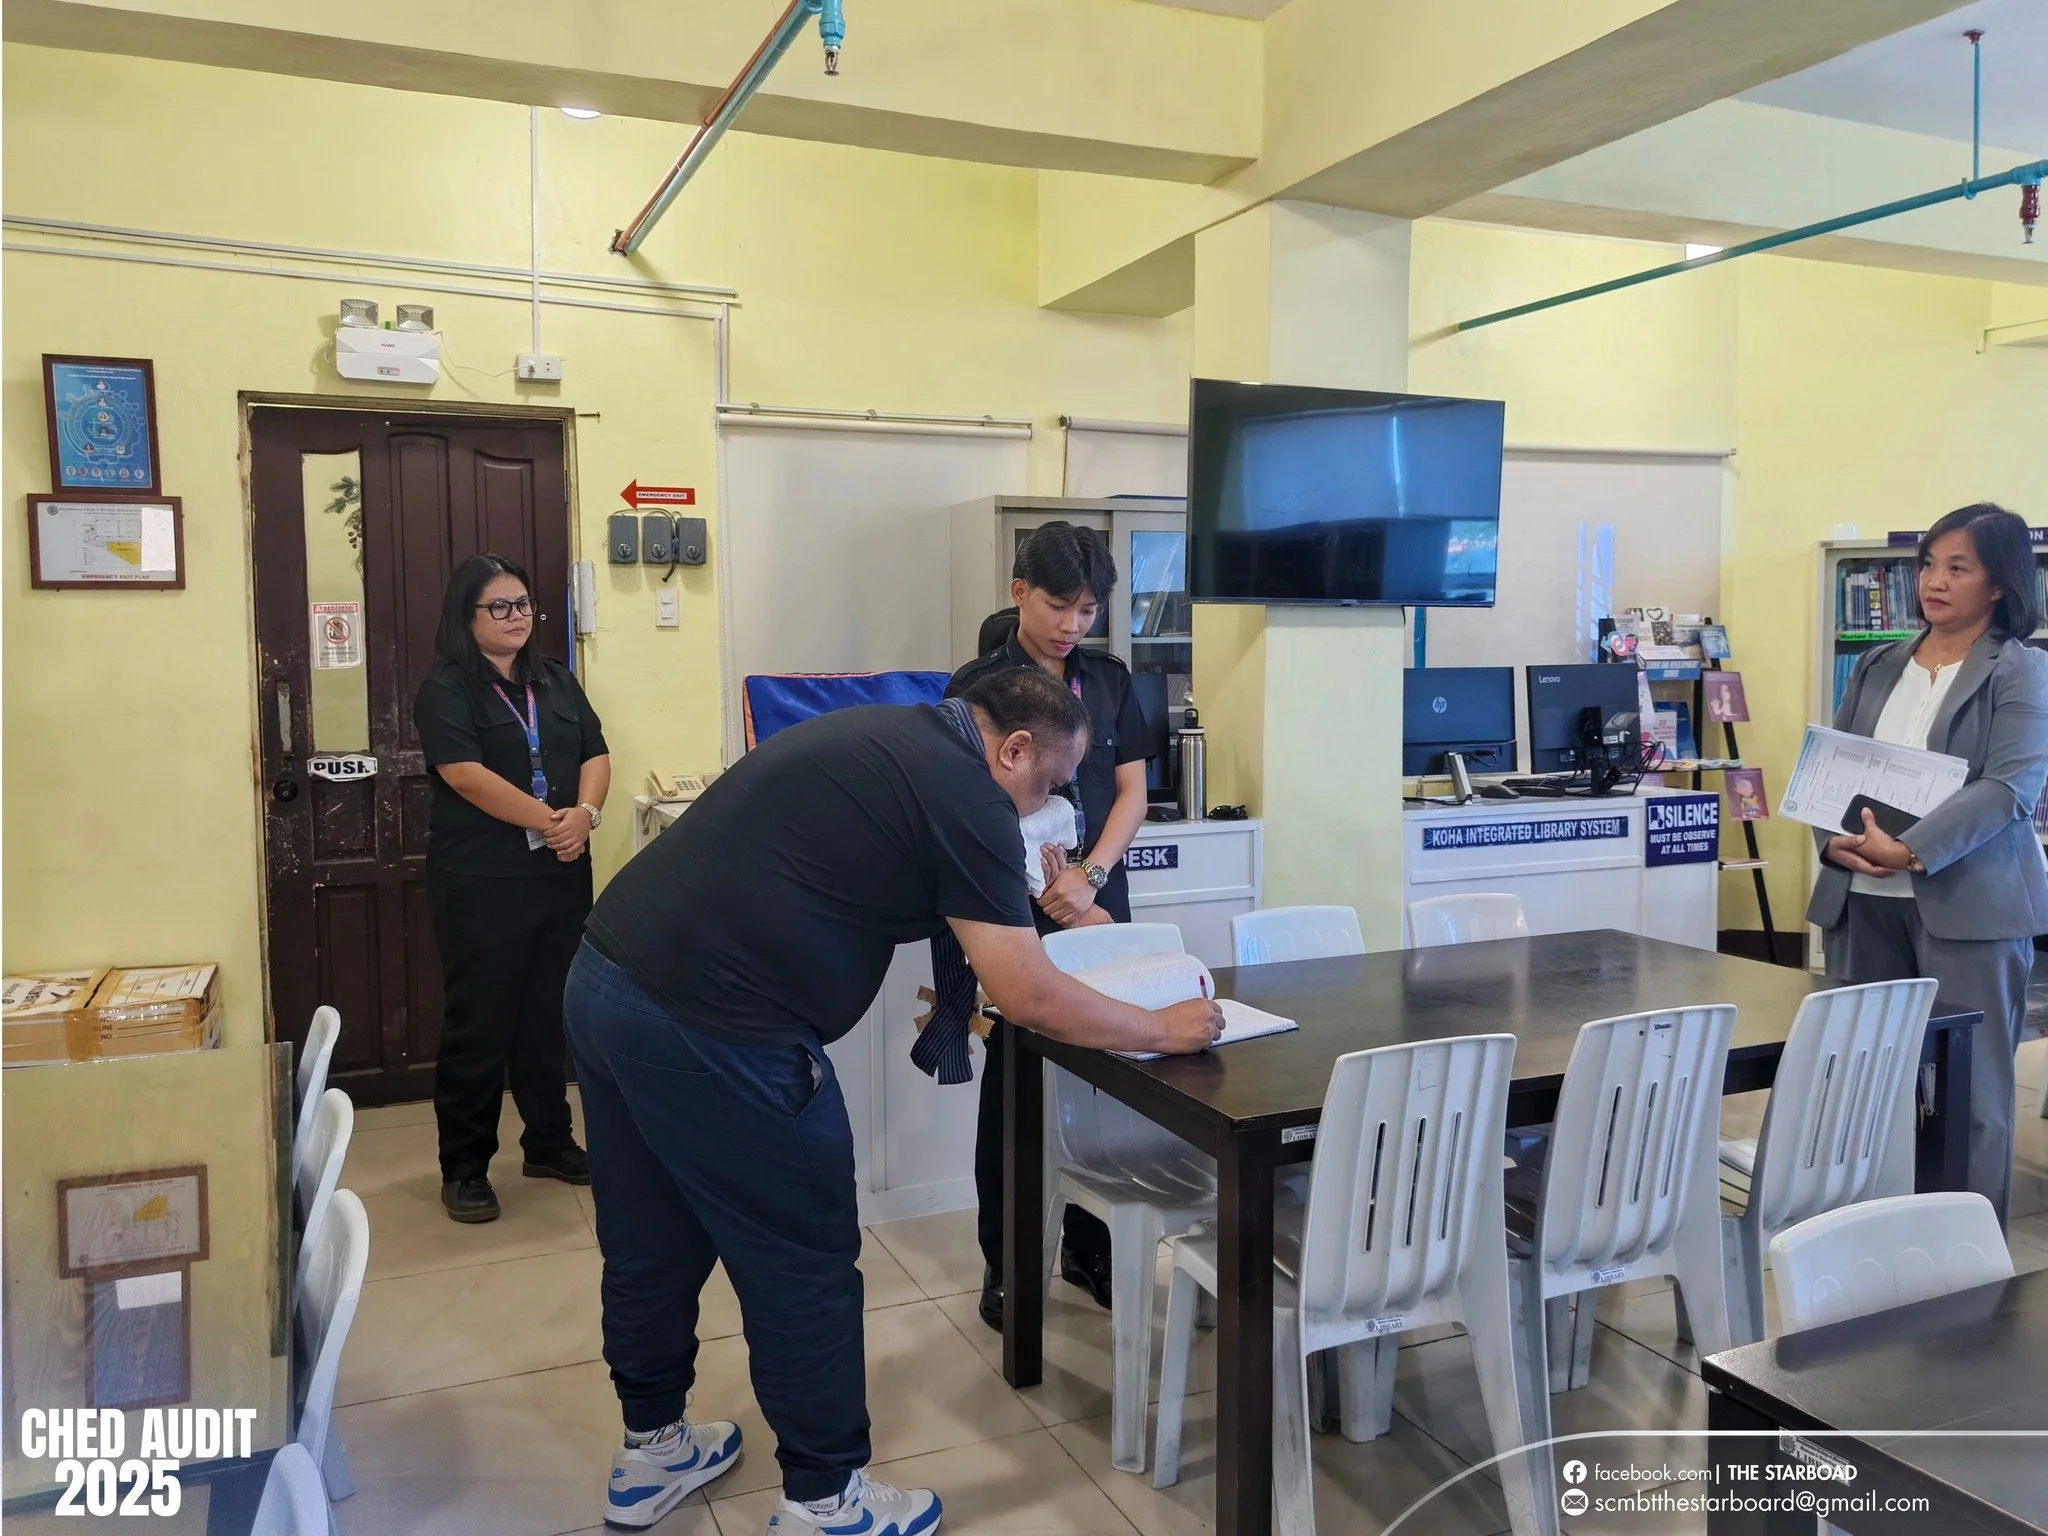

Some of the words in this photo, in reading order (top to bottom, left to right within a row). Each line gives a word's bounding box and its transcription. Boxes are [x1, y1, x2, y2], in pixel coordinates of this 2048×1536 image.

[315, 604, 357, 612] ATTENTION
[1539, 676, 1561, 684] Lenovo
[1432, 696, 1448, 714] hp
[1665, 803, 1718, 828] SILENCE
[1433, 828, 1463, 846] KOHA
[1466, 824, 1532, 844] INTEGRATED
[1534, 821, 1578, 839] LIBRARY
[1580, 818, 1620, 836] SYSTEM
[1650, 833, 1671, 844] MUST
[1672, 832, 1682, 842] BE
[1683, 829, 1716, 841] OBSERVE
[1660, 845, 1671, 855] AT
[1671, 843, 1686, 854] ALL
[1687, 841, 1709, 852] TIMES
